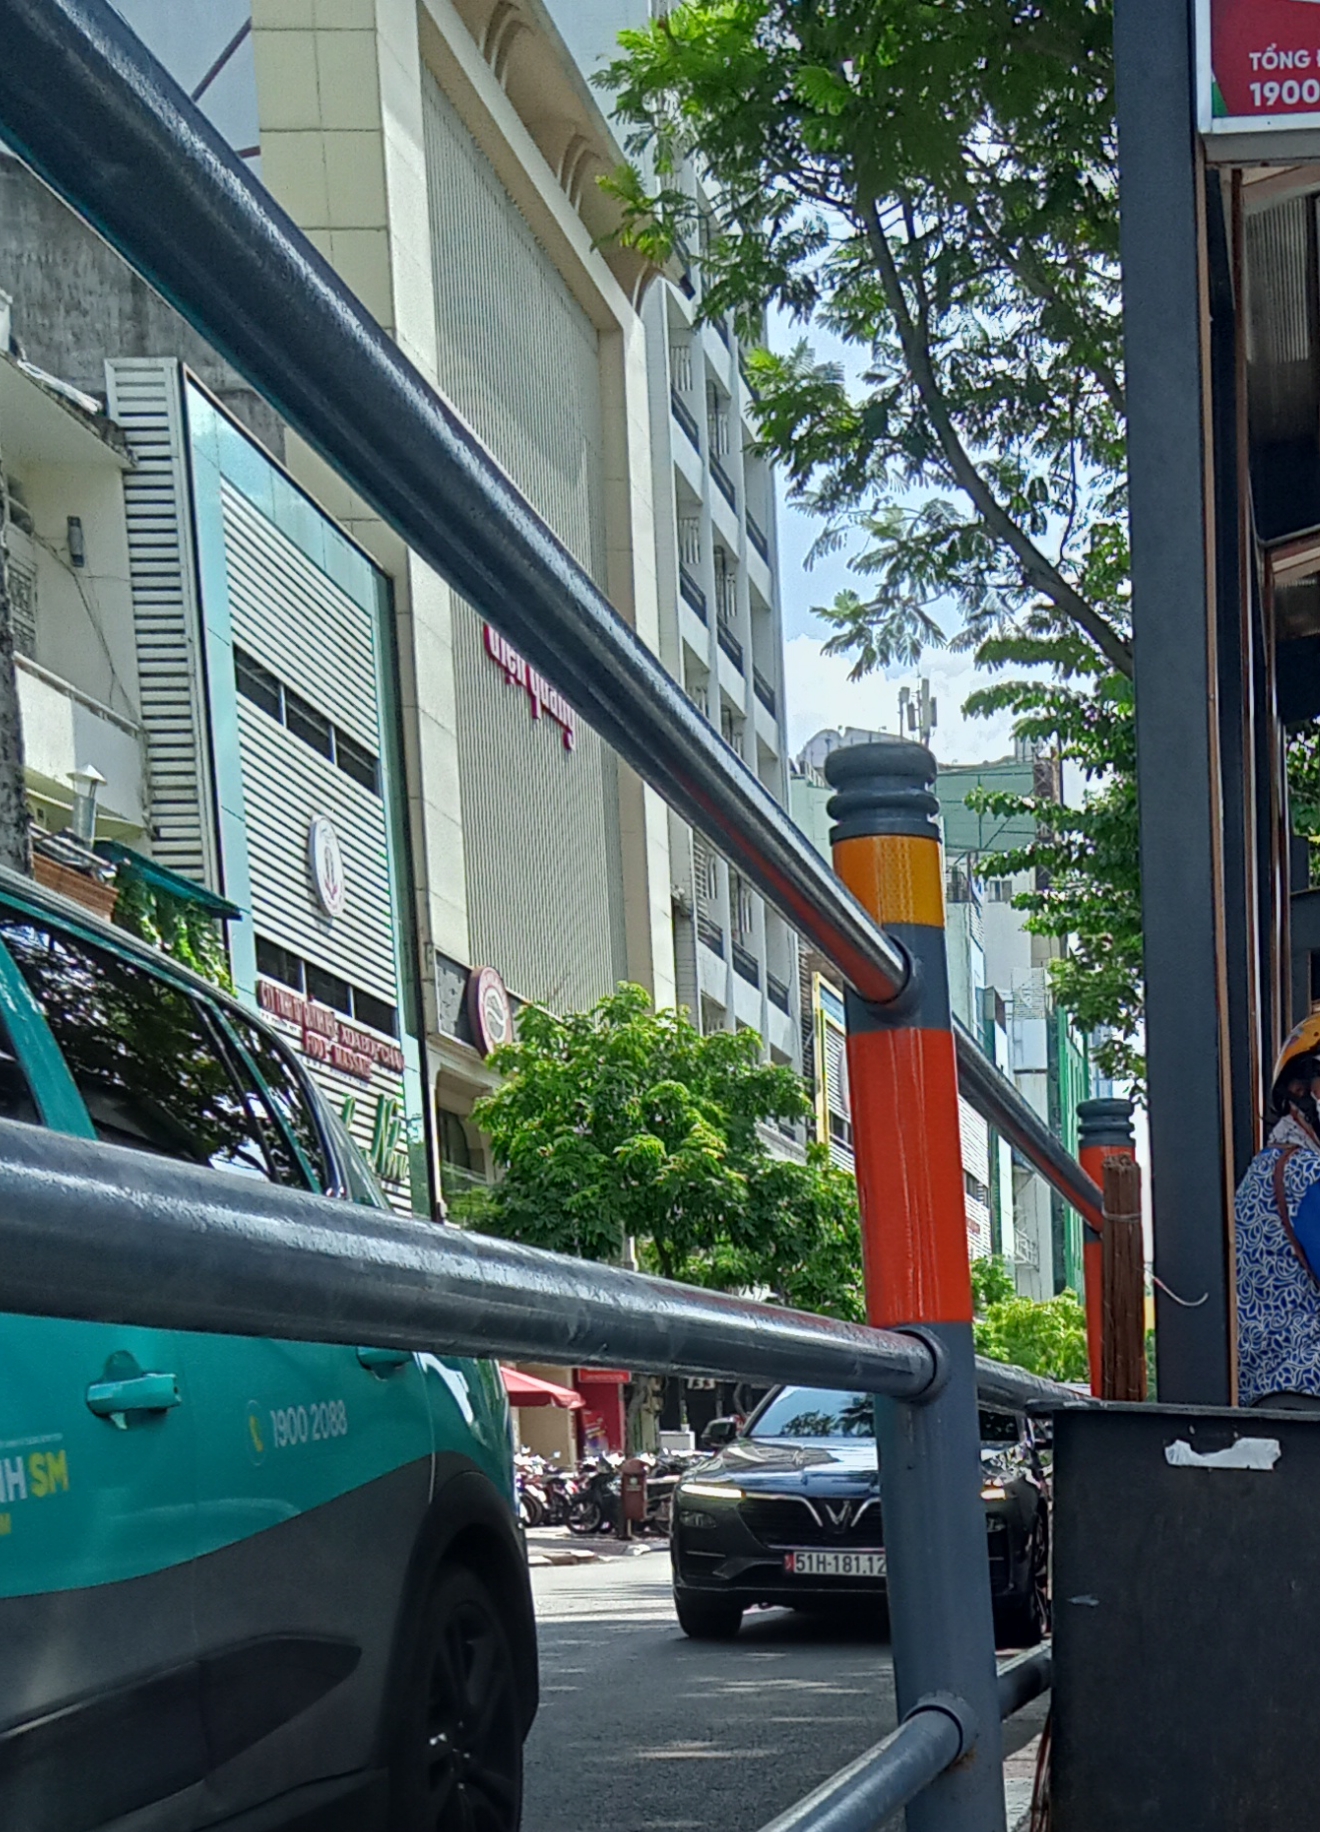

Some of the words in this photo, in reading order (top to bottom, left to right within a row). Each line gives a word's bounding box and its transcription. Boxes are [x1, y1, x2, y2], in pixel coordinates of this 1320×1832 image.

[1249, 43, 1311, 71] TỔNG
[1249, 78, 1320, 107] 1900
[270, 1404, 308, 1449] 1900
[309, 1399, 348, 1442] 2088
[29, 1449, 70, 1498] SM
[795, 1553, 886, 1576] 51H-181.12
